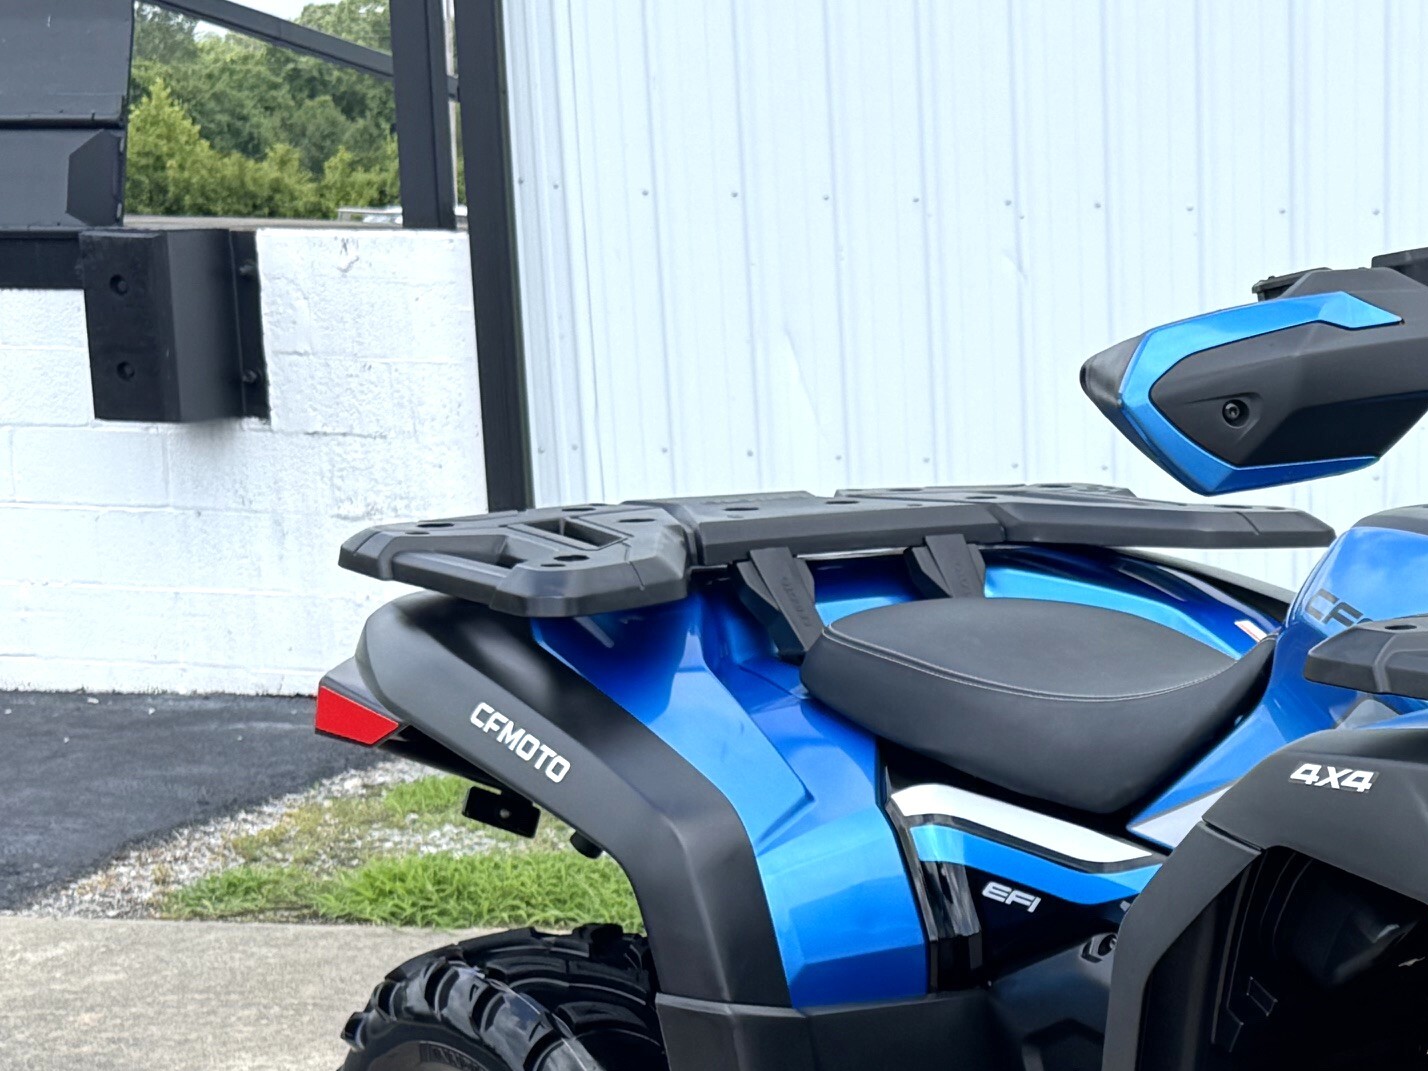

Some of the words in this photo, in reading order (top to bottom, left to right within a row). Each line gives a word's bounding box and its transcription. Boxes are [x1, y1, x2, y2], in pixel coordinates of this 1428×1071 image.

[470, 702, 571, 783] CFMOTO
[1290, 763, 1375, 793] 4X4
[982, 881, 1042, 913] EFI
